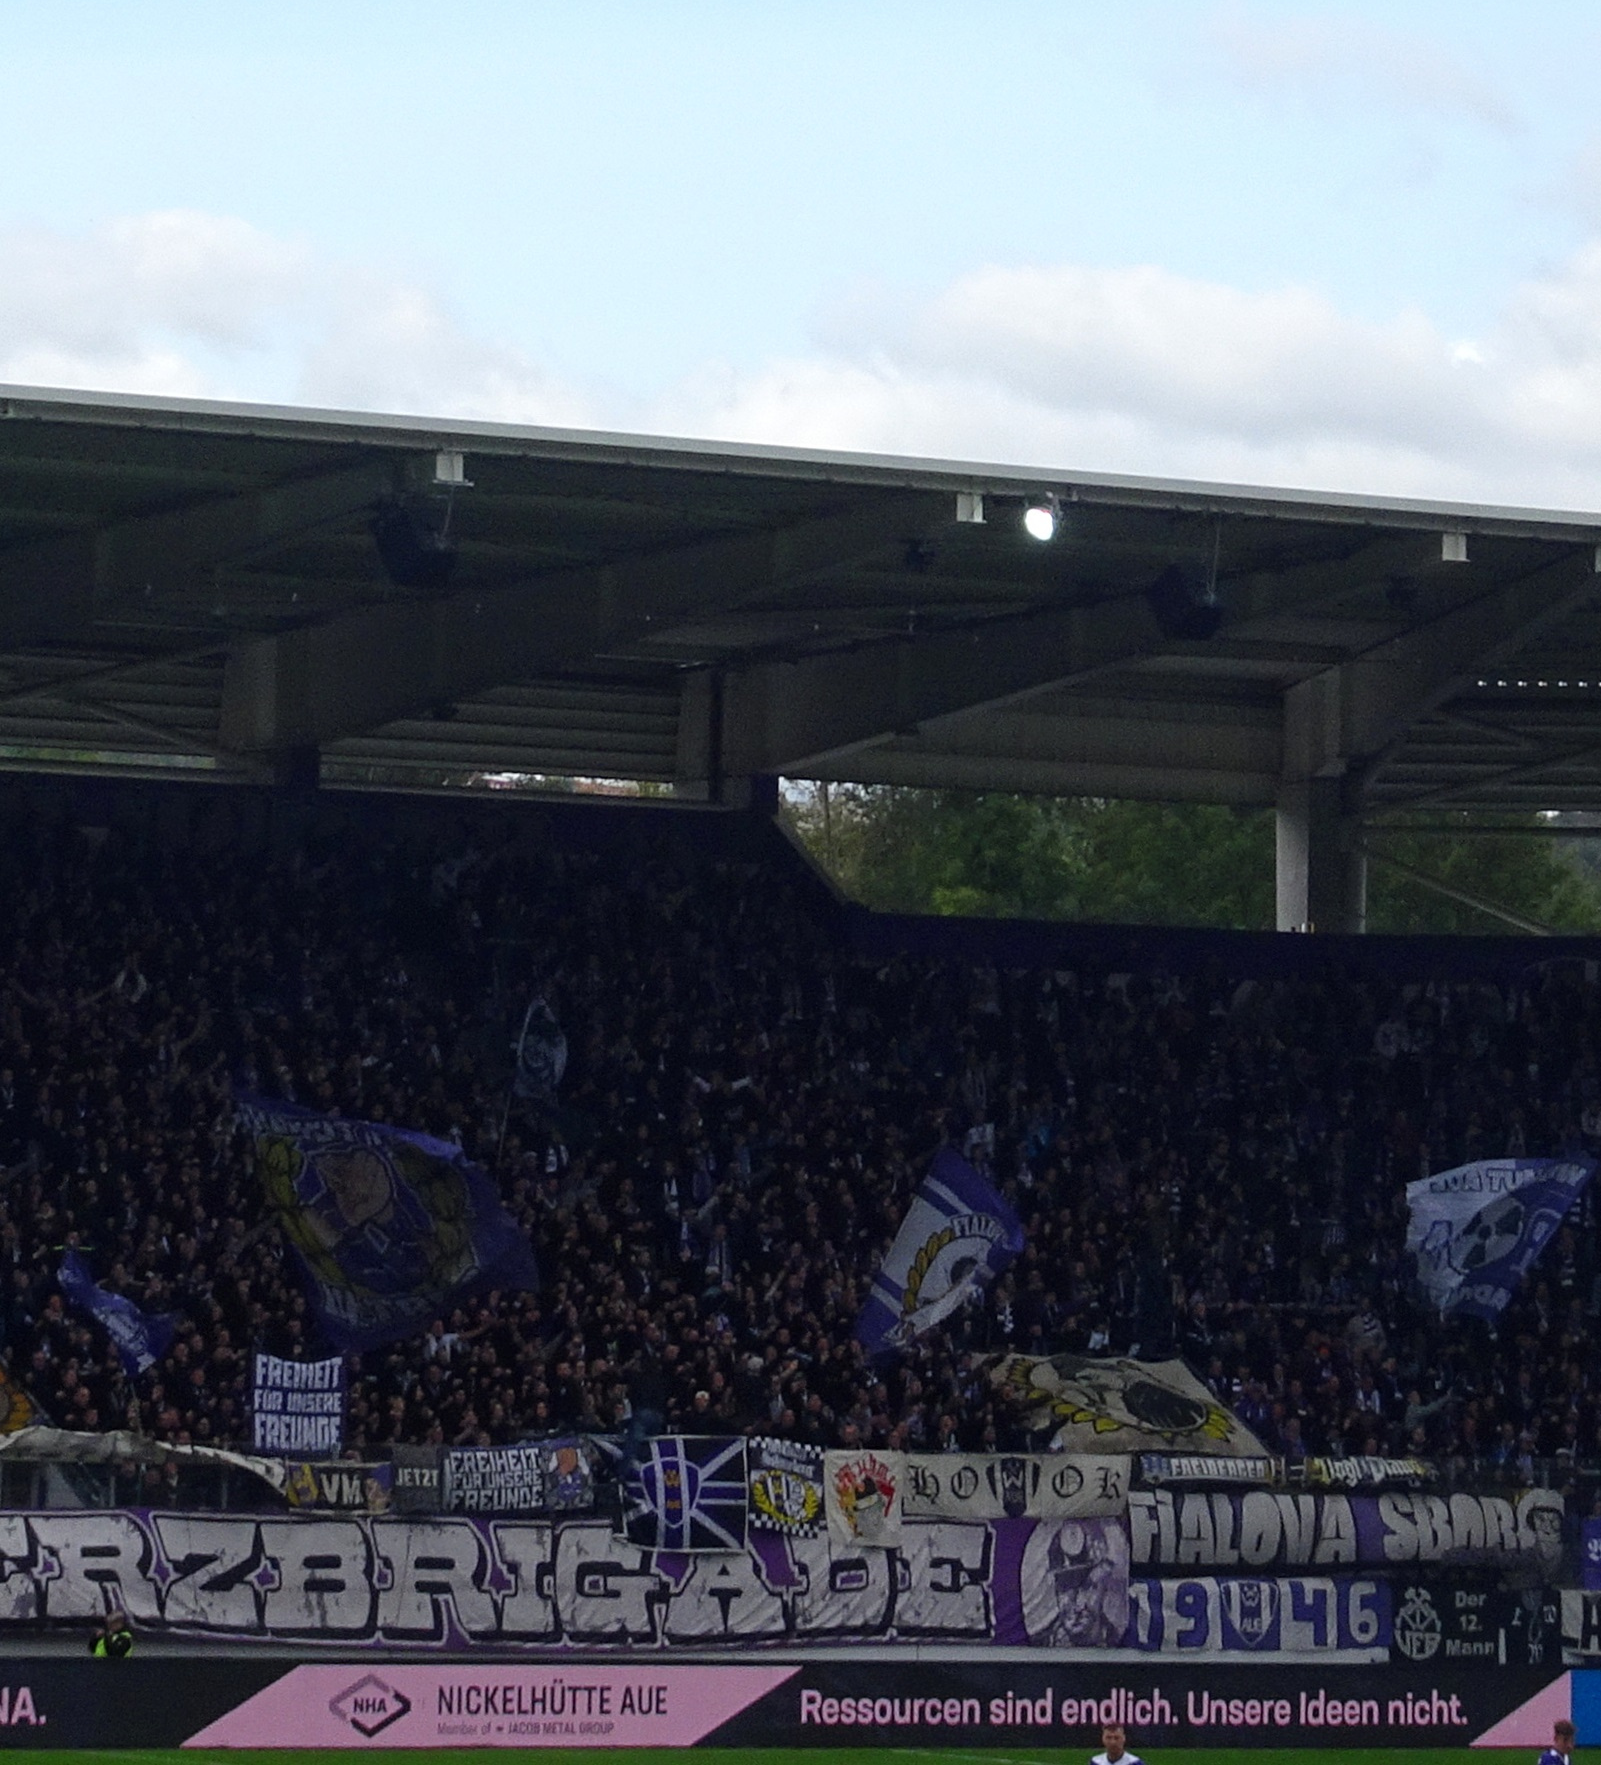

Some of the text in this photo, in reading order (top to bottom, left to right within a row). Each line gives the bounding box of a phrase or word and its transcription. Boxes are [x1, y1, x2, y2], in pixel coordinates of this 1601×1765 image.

[256, 1353, 343, 1390] FREIHEIT
[287, 1391, 342, 1414] UNSERE
[254, 1413, 341, 1452] FREUNDE
[450, 1447, 539, 1473] FREIHEIT
[396, 1468, 438, 1487] JETZT
[486, 1470, 542, 1490] UNSERE
[450, 1486, 543, 1511] FREUNDE
[1455, 1590, 1487, 1609] Der
[1459, 1614, 1483, 1632] 12.
[1446, 1639, 1496, 1657] Mann
[353, 1697, 387, 1714] NHA
[437, 1678, 669, 1715] NICKELHÜTTE AUE
[801, 1688, 1469, 1727] Ressourcen sind endlich. Unsere Ideen nicht.
